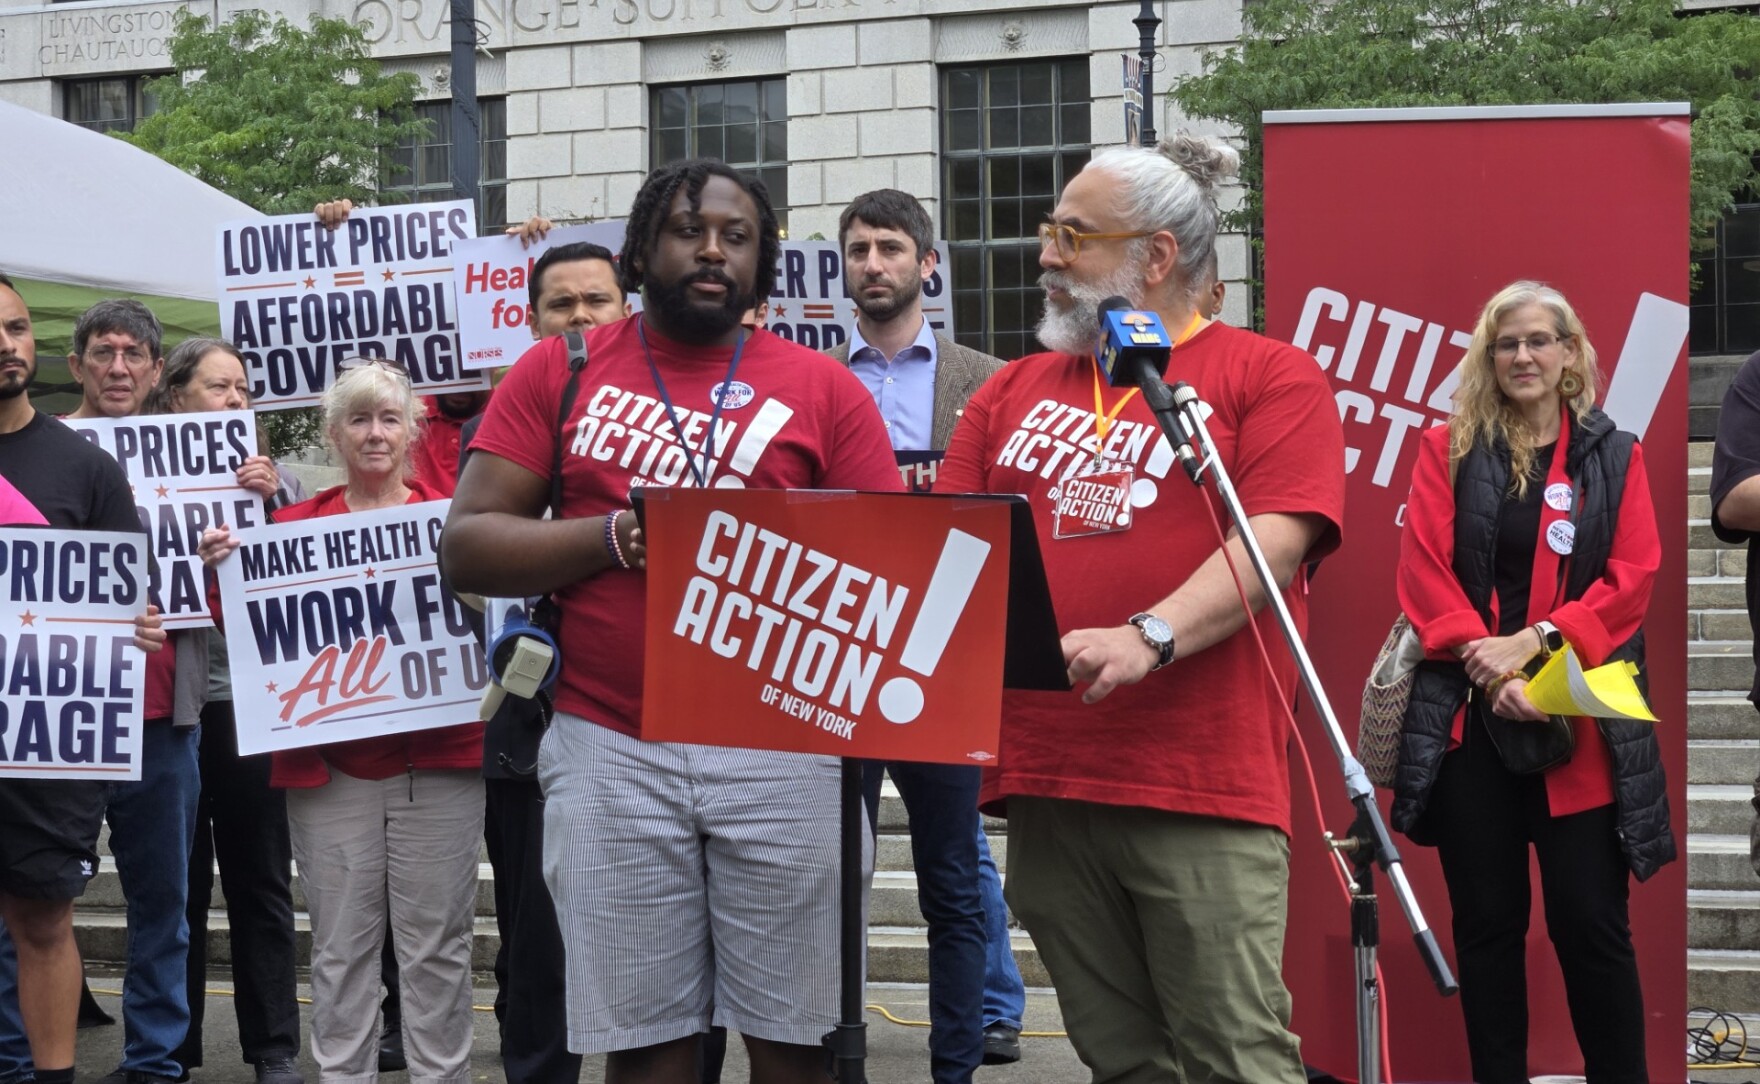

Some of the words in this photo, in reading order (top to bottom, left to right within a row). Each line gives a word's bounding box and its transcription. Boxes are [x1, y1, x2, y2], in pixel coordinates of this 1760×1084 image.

[223, 222, 338, 276] LOWER
[348, 208, 468, 265] PRICES
[232, 282, 458, 350] AFFORDABL
[1292, 287, 1473, 415] CITIZ
[587, 385, 738, 458] CITIZEN
[1065, 480, 1125, 506] CITIZEN
[239, 535, 318, 582] MAKE
[323, 520, 421, 569] HEALTH
[696, 510, 910, 650] CITIZEN
[246, 579, 405, 666] WORK
[412, 573, 473, 643] FO
[278, 635, 391, 722] All
[400, 647, 448, 700] OF
[761, 684, 779, 703] OF
[780, 694, 816, 722] NEW
[815, 715, 857, 740] YORK
